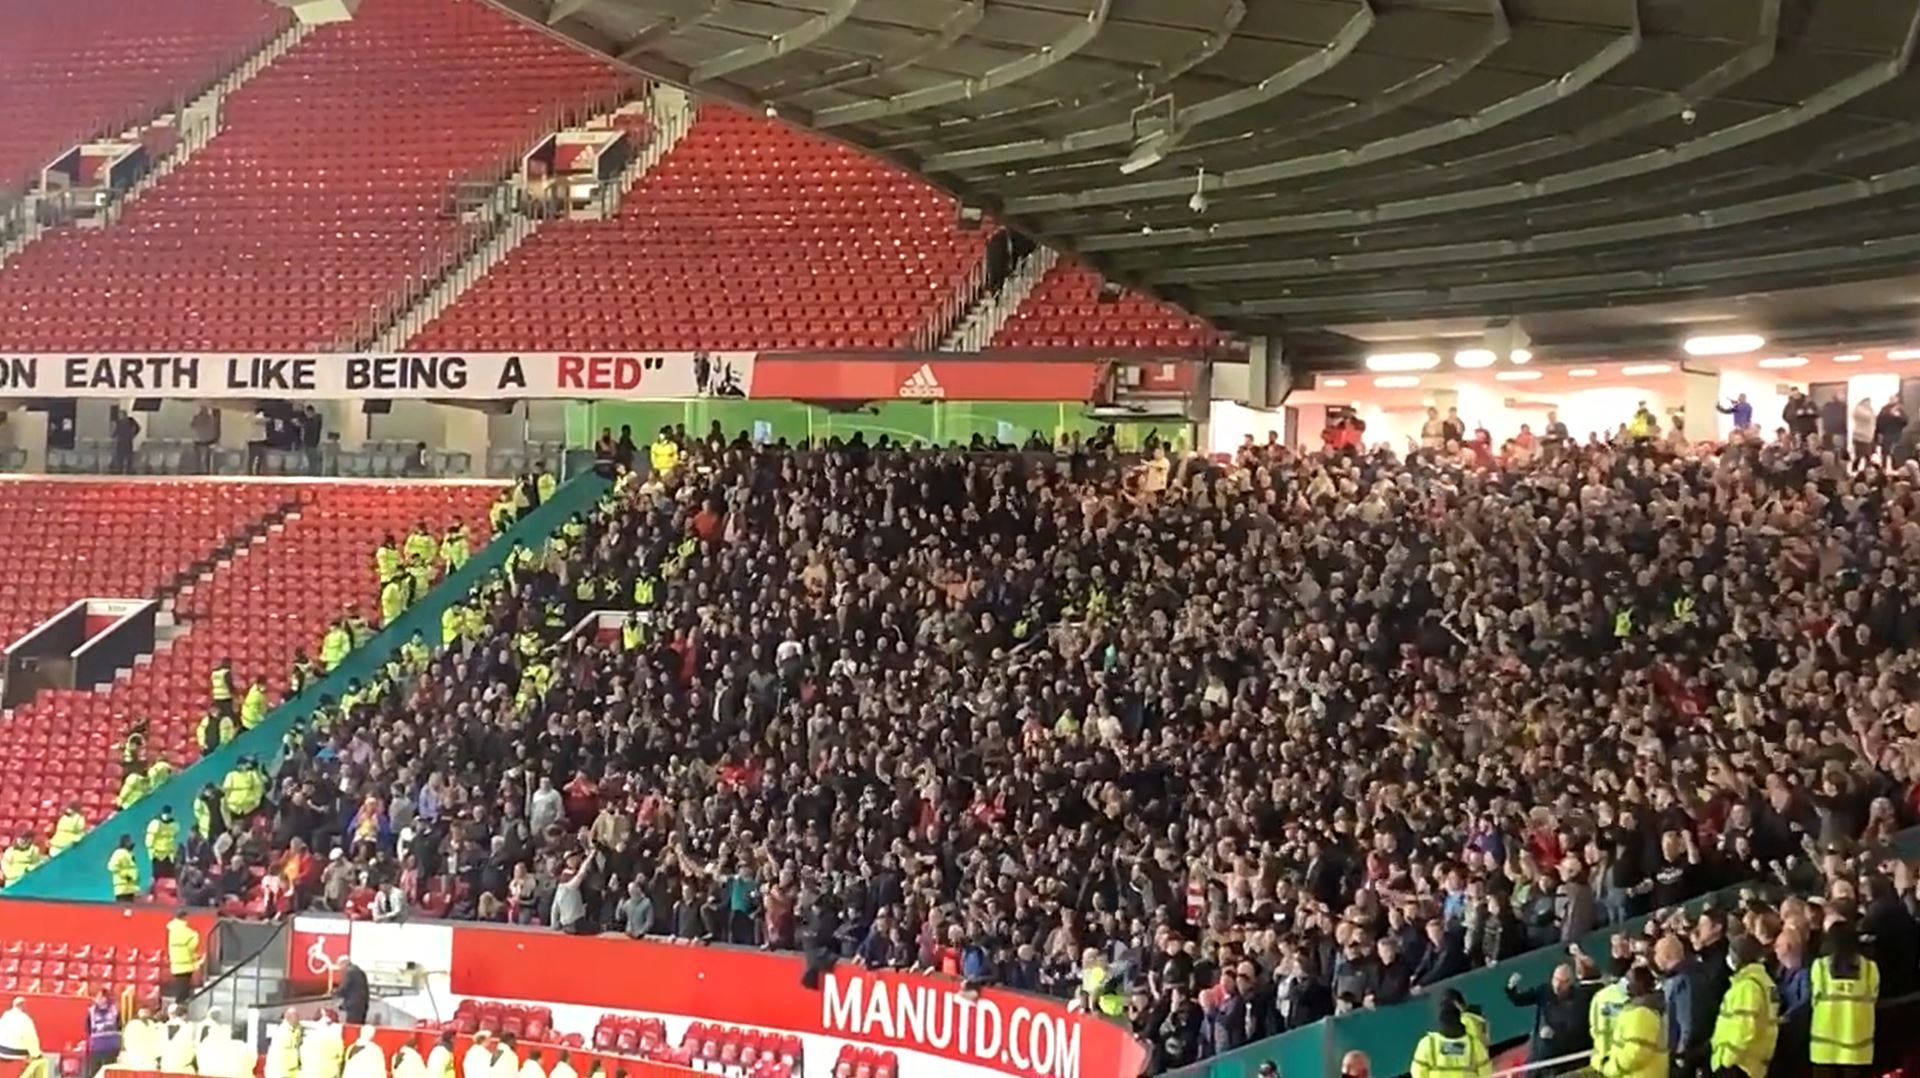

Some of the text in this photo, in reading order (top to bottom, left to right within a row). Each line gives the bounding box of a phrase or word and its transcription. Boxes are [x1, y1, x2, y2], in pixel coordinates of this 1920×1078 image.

[65, 358, 199, 389] EARTH
[227, 358, 316, 389] LIKE
[346, 357, 467, 390] BEING
[498, 356, 527, 389] A
[899, 386, 945, 398] adidas
[822, 973, 1081, 1078] MANUTD.COM
